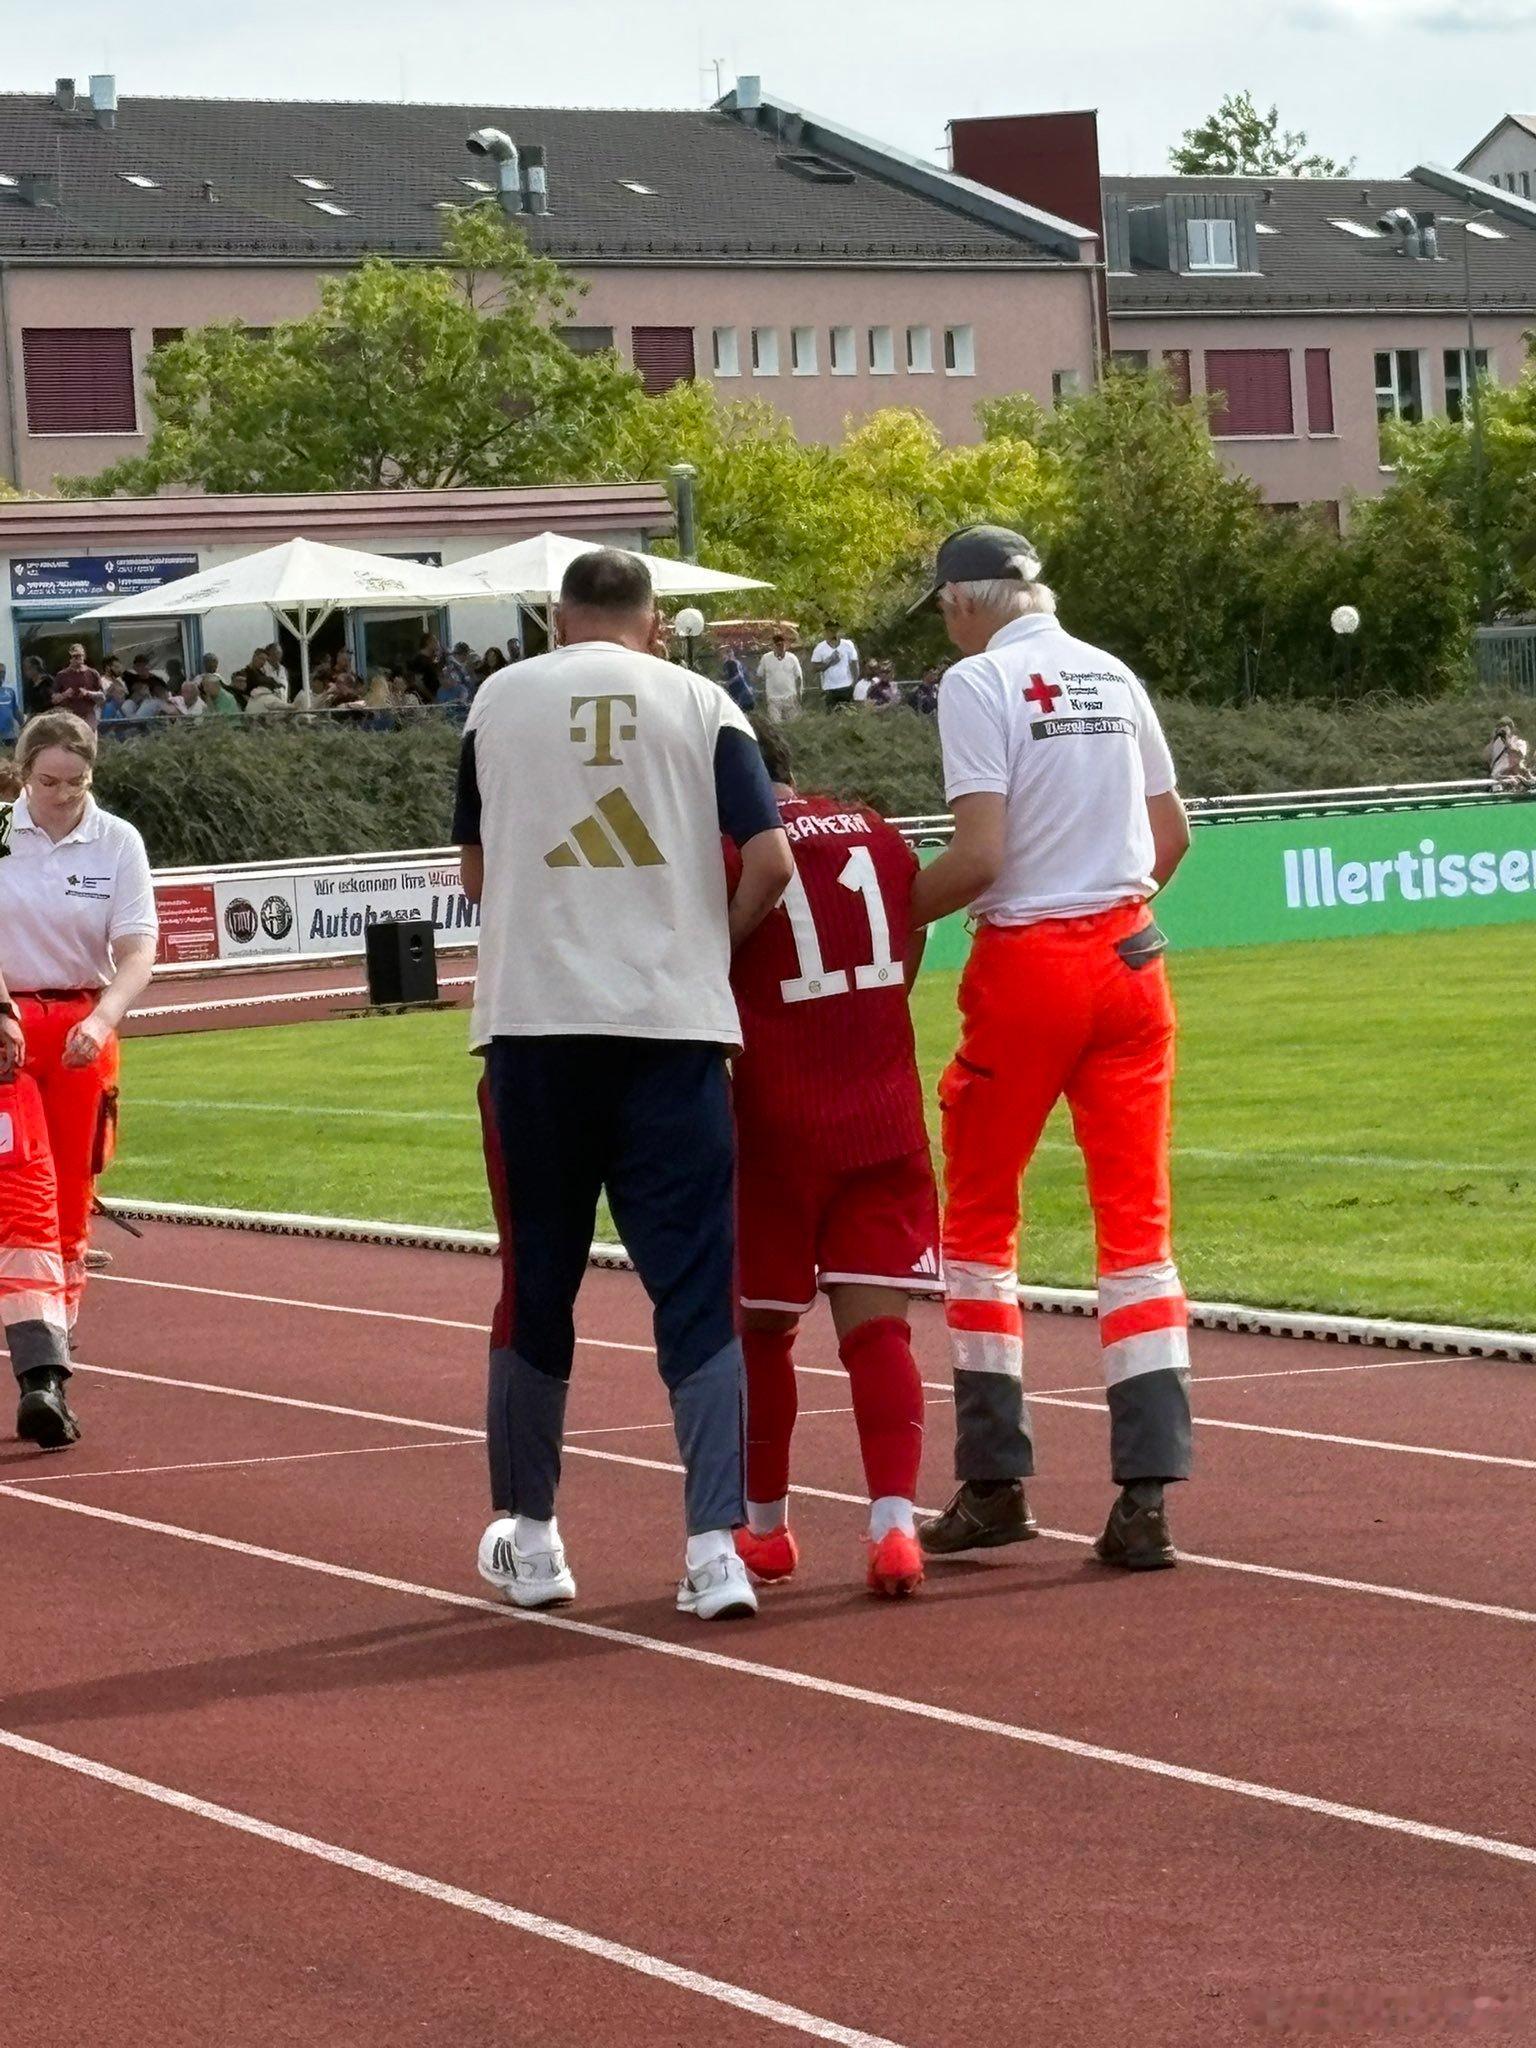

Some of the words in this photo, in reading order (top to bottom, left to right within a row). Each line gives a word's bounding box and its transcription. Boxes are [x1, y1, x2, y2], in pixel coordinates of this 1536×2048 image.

[785, 813, 872, 841] BAYERN
[1283, 838, 1536, 908] Illertisse
[774, 846, 905, 1003] 11
